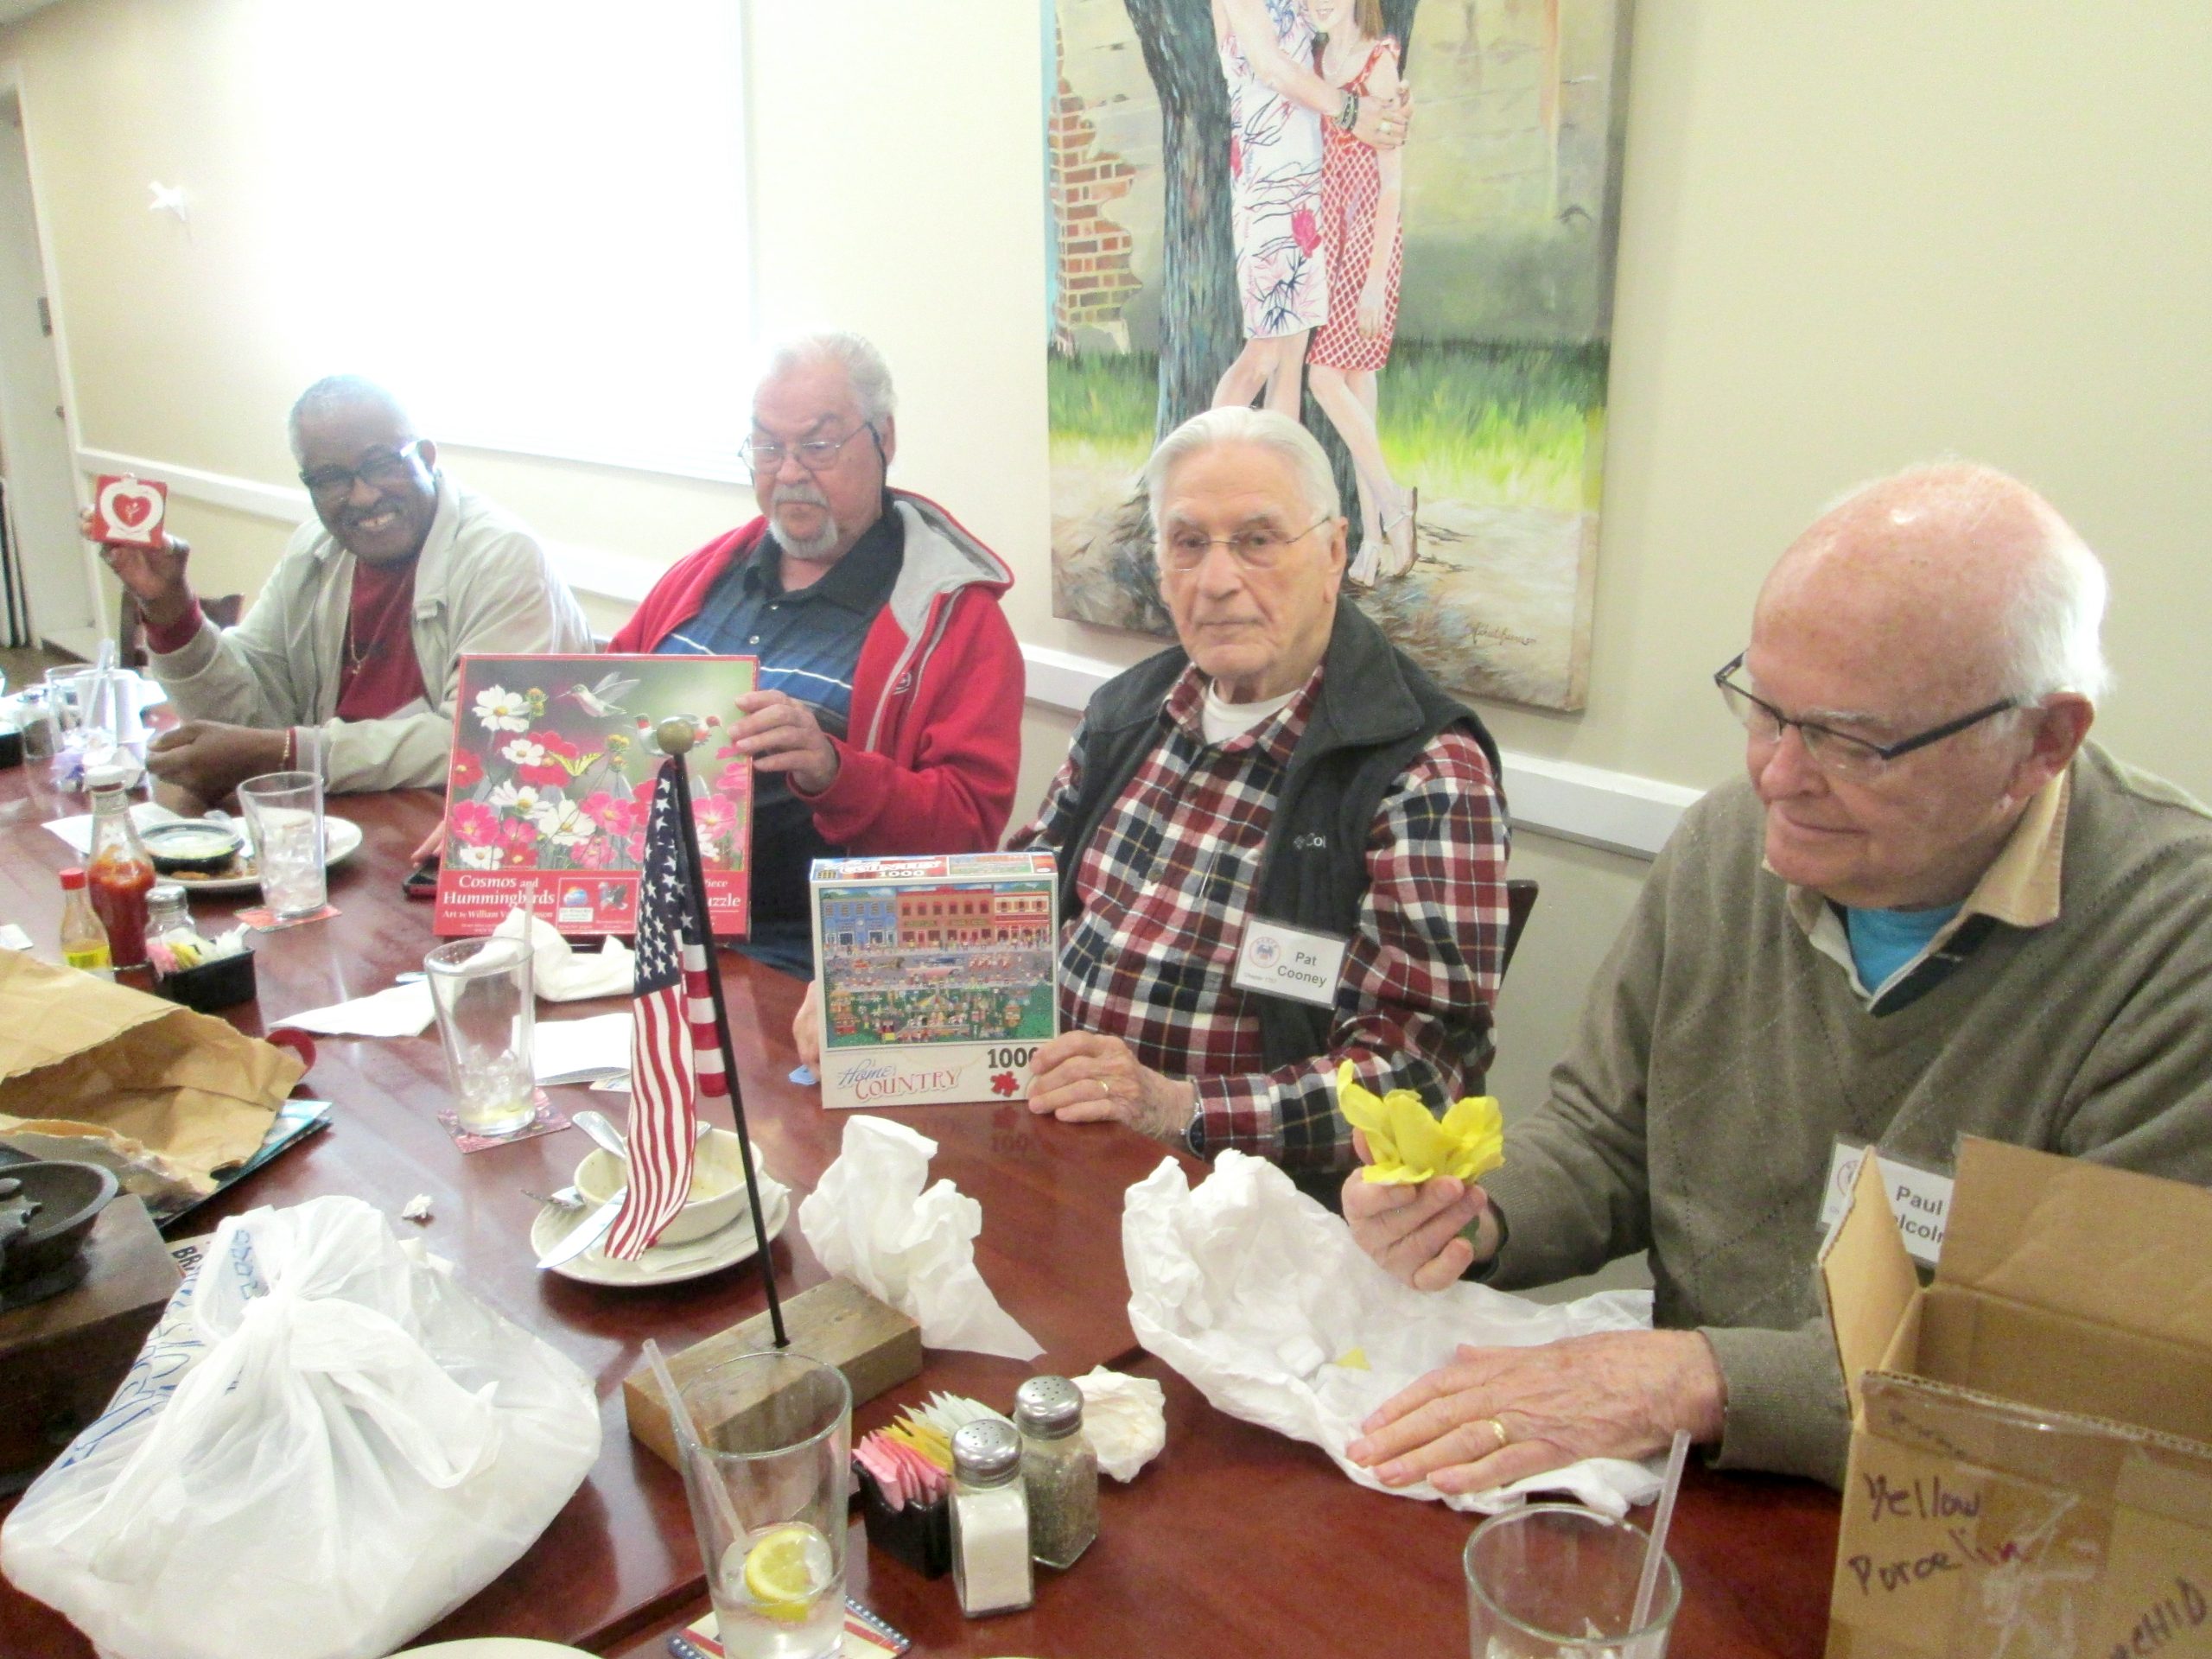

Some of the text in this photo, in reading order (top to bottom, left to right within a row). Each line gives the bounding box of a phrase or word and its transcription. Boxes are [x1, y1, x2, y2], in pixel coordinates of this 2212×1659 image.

[459, 874, 539, 888] Cosmos and
[879, 869, 925, 878] 1000
[442, 889, 556, 908] Hummingbrds
[442, 910, 457, 918] Art
[467, 909, 499, 918] William
[1295, 951, 1318, 967] Pat
[1277, 965, 1327, 988] Cooney
[836, 1058, 893, 1086] Home
[855, 1069, 962, 1100] COUNTRY
[1896, 1185, 1943, 1216] Paul
[1894, 1213, 1943, 1243] lcol
[1863, 1471, 1980, 1522] Yellow
